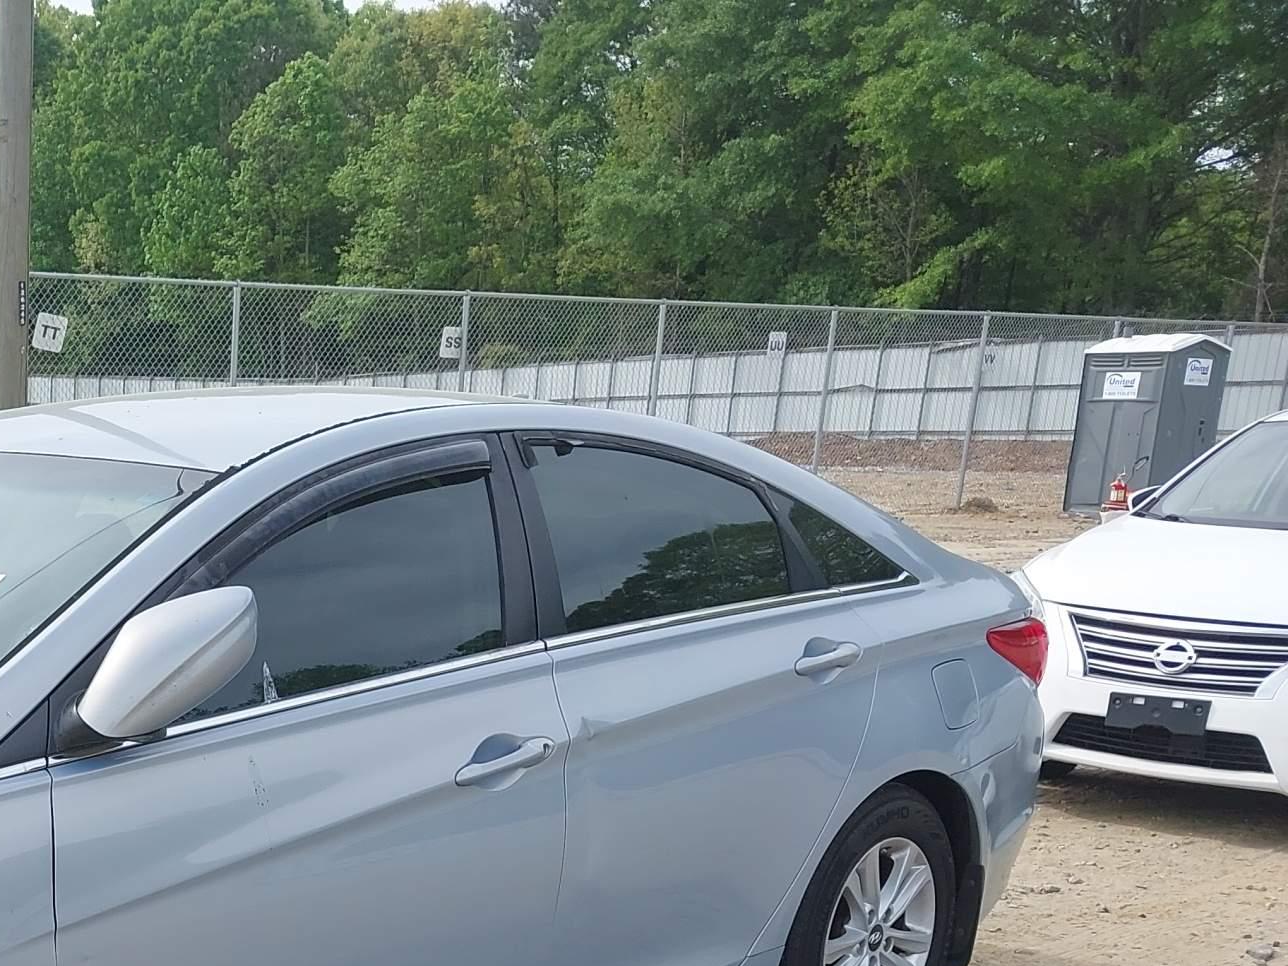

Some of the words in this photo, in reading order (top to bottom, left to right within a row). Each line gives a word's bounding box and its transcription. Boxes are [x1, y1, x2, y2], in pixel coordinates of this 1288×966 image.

[41, 323, 61, 340] TT
[445, 336, 462, 348] SS
[1109, 377, 1136, 385] United
